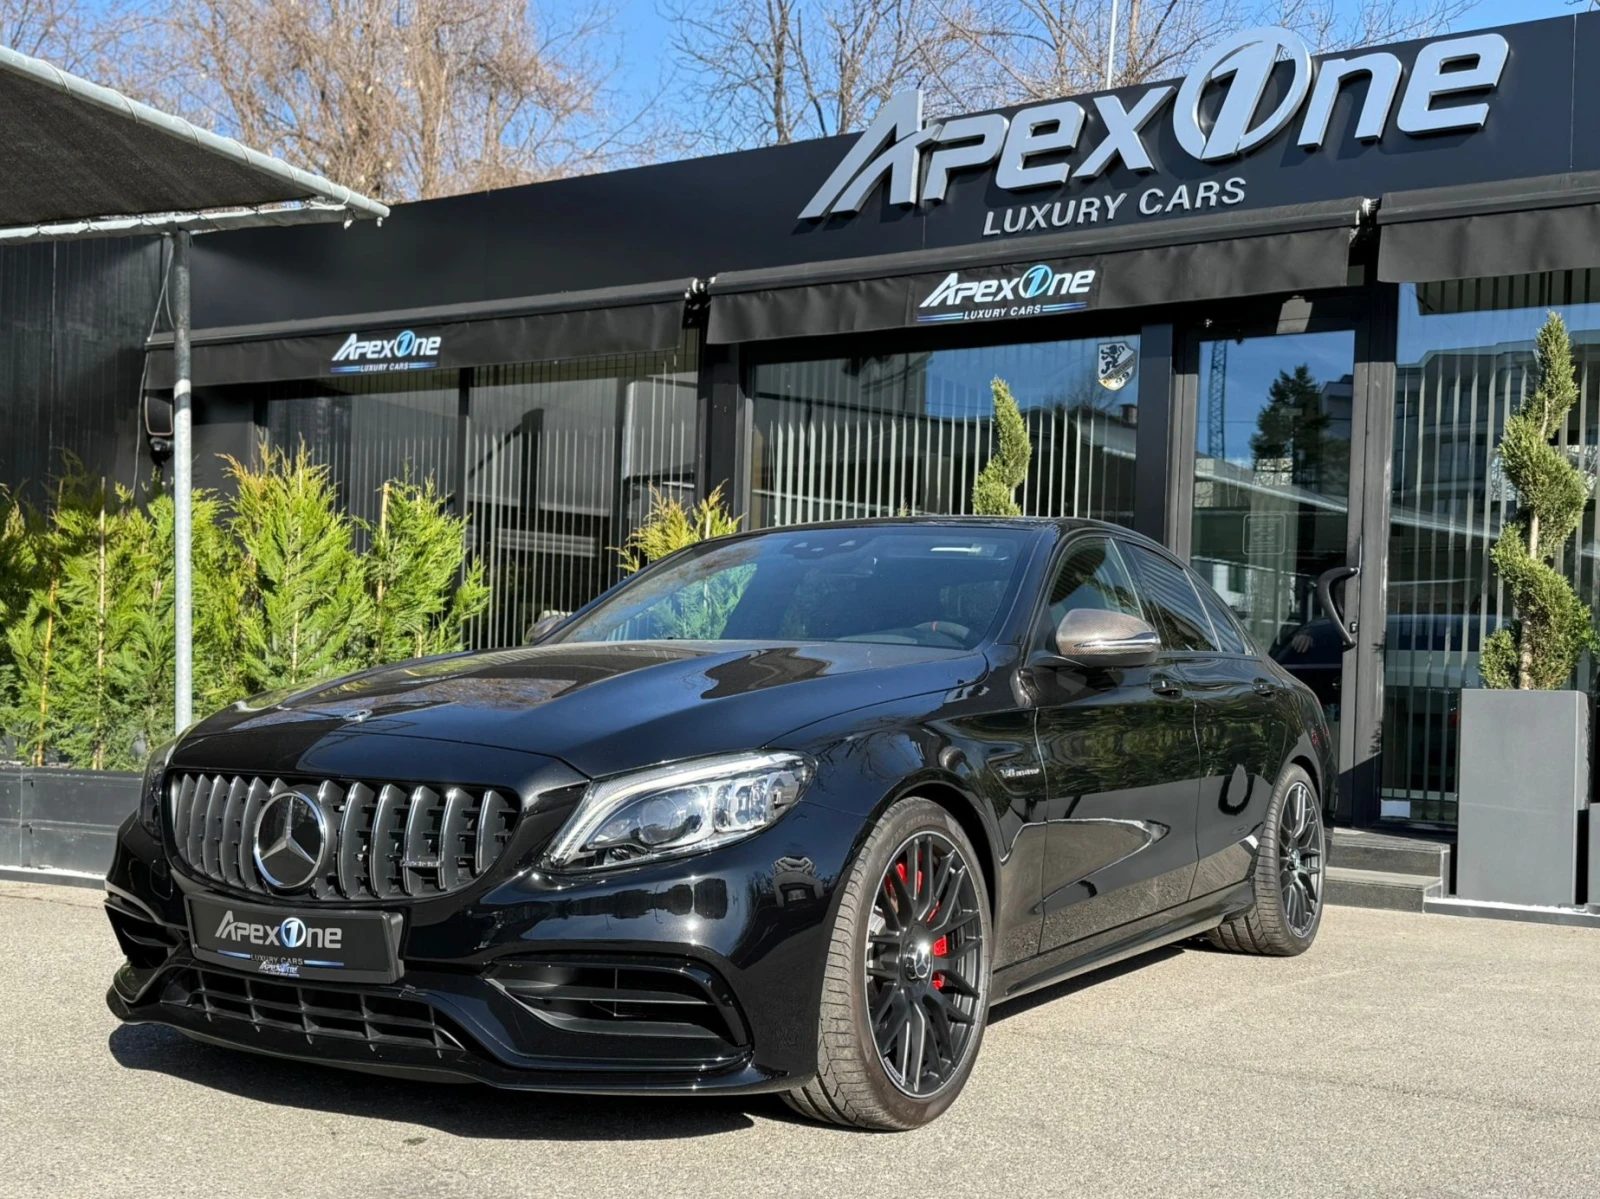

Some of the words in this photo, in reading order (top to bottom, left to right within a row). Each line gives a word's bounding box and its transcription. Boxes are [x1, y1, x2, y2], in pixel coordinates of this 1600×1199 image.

[982, 193, 1127, 236] LUXURY
[1139, 177, 1246, 215] CARS
[963, 307, 1007, 320] LUXURY
[1010, 305, 1041, 316] CARS
[360, 363, 387, 372] LUXURY
[389, 362, 410, 371] CARS
